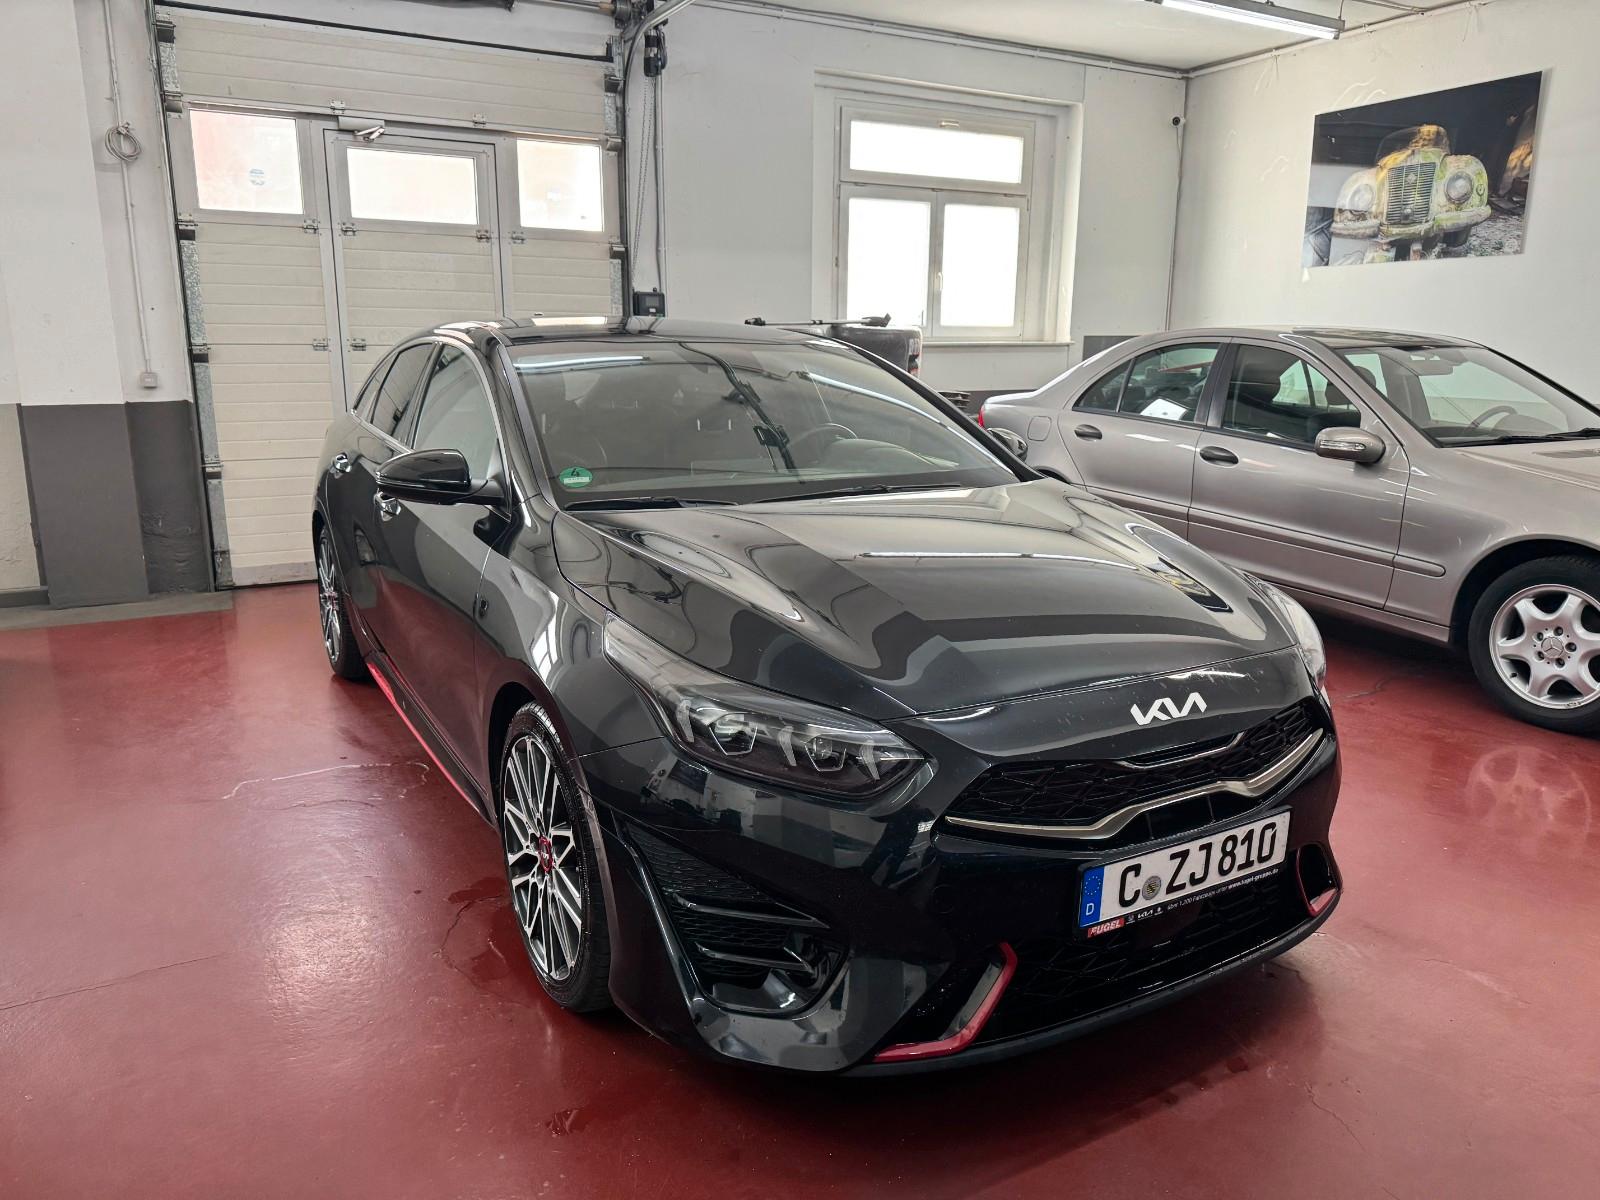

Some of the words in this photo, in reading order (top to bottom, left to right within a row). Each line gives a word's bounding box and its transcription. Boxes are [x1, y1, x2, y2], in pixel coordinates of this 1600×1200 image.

[1130, 692, 1207, 726] KIA
[1118, 862, 1142, 908] C
[1086, 902, 1095, 916] D
[1090, 919, 1121, 935] FUGEL
